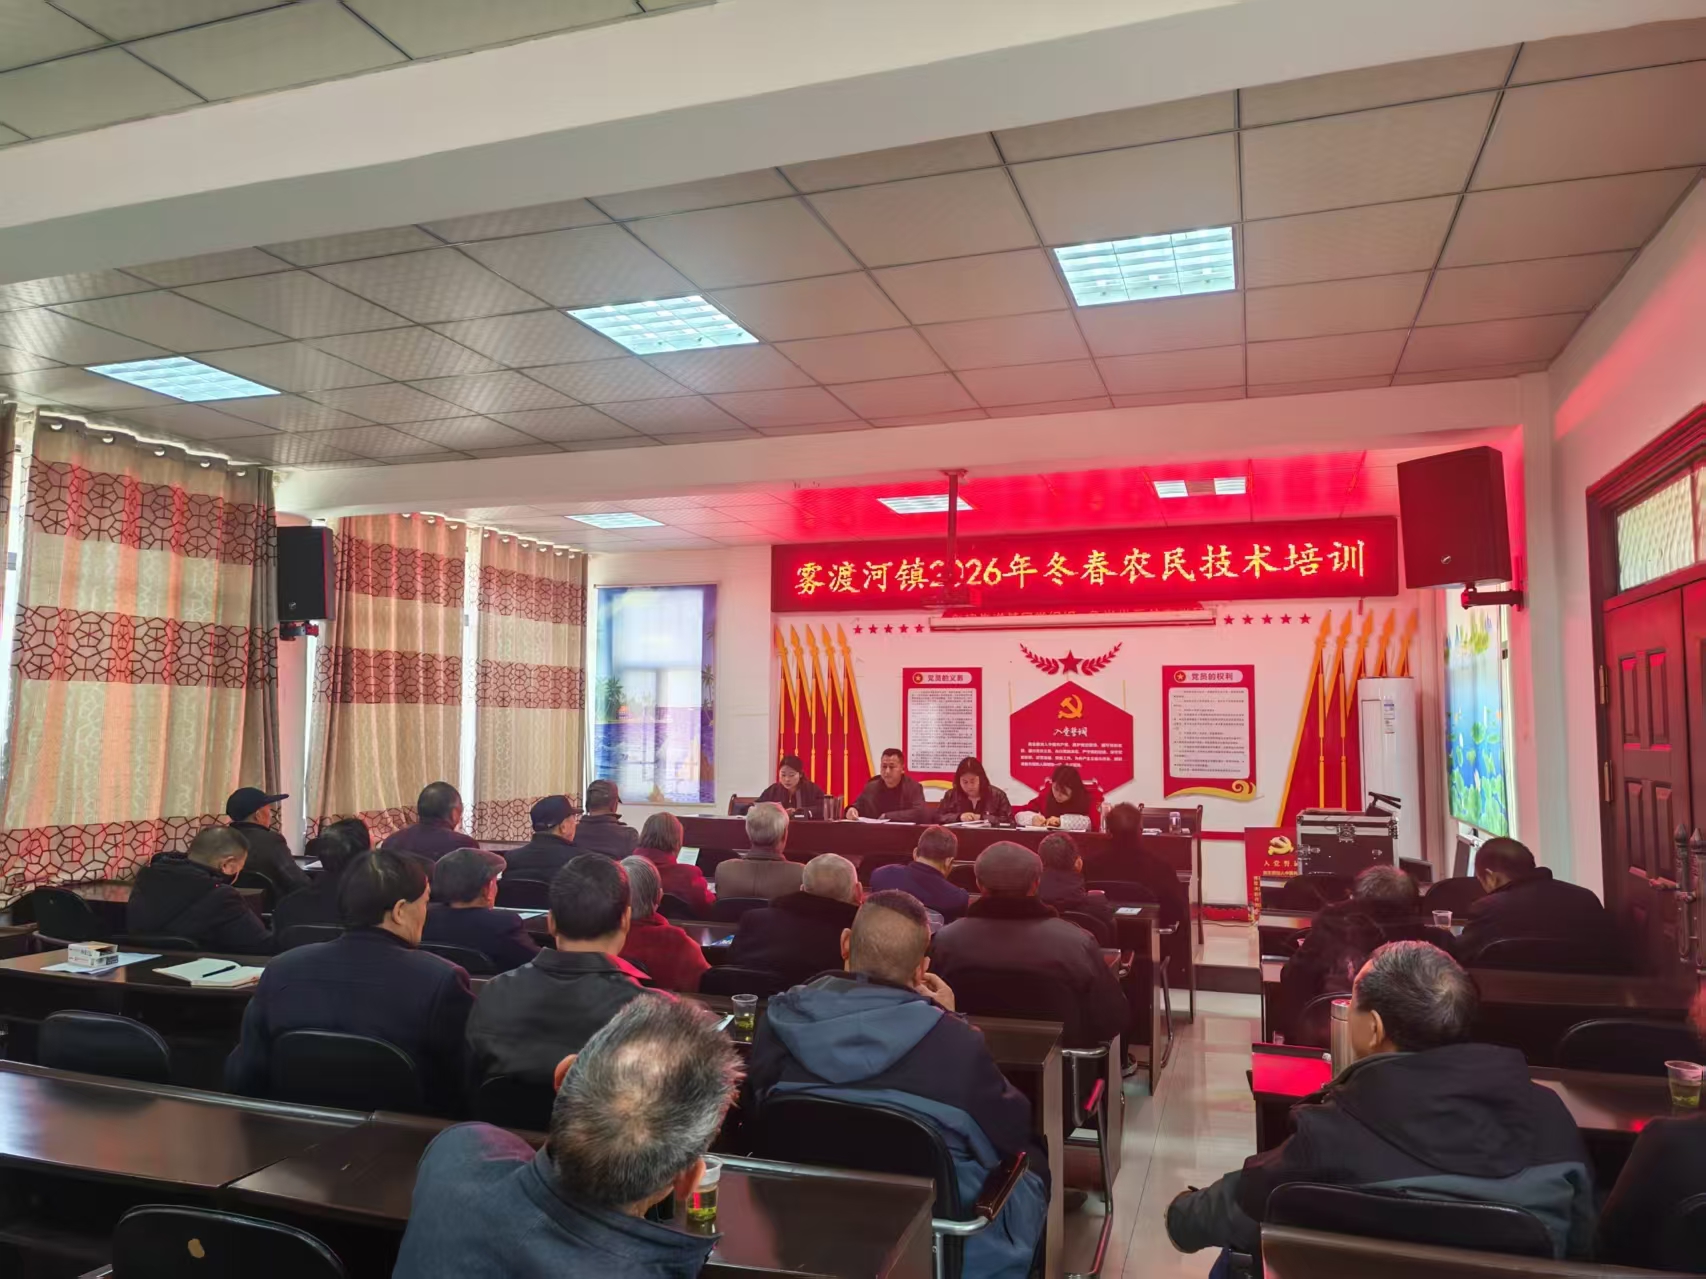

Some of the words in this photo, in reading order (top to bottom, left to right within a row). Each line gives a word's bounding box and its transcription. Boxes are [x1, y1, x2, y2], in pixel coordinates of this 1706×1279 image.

[1191, 672, 1234, 681] 党员的权利
